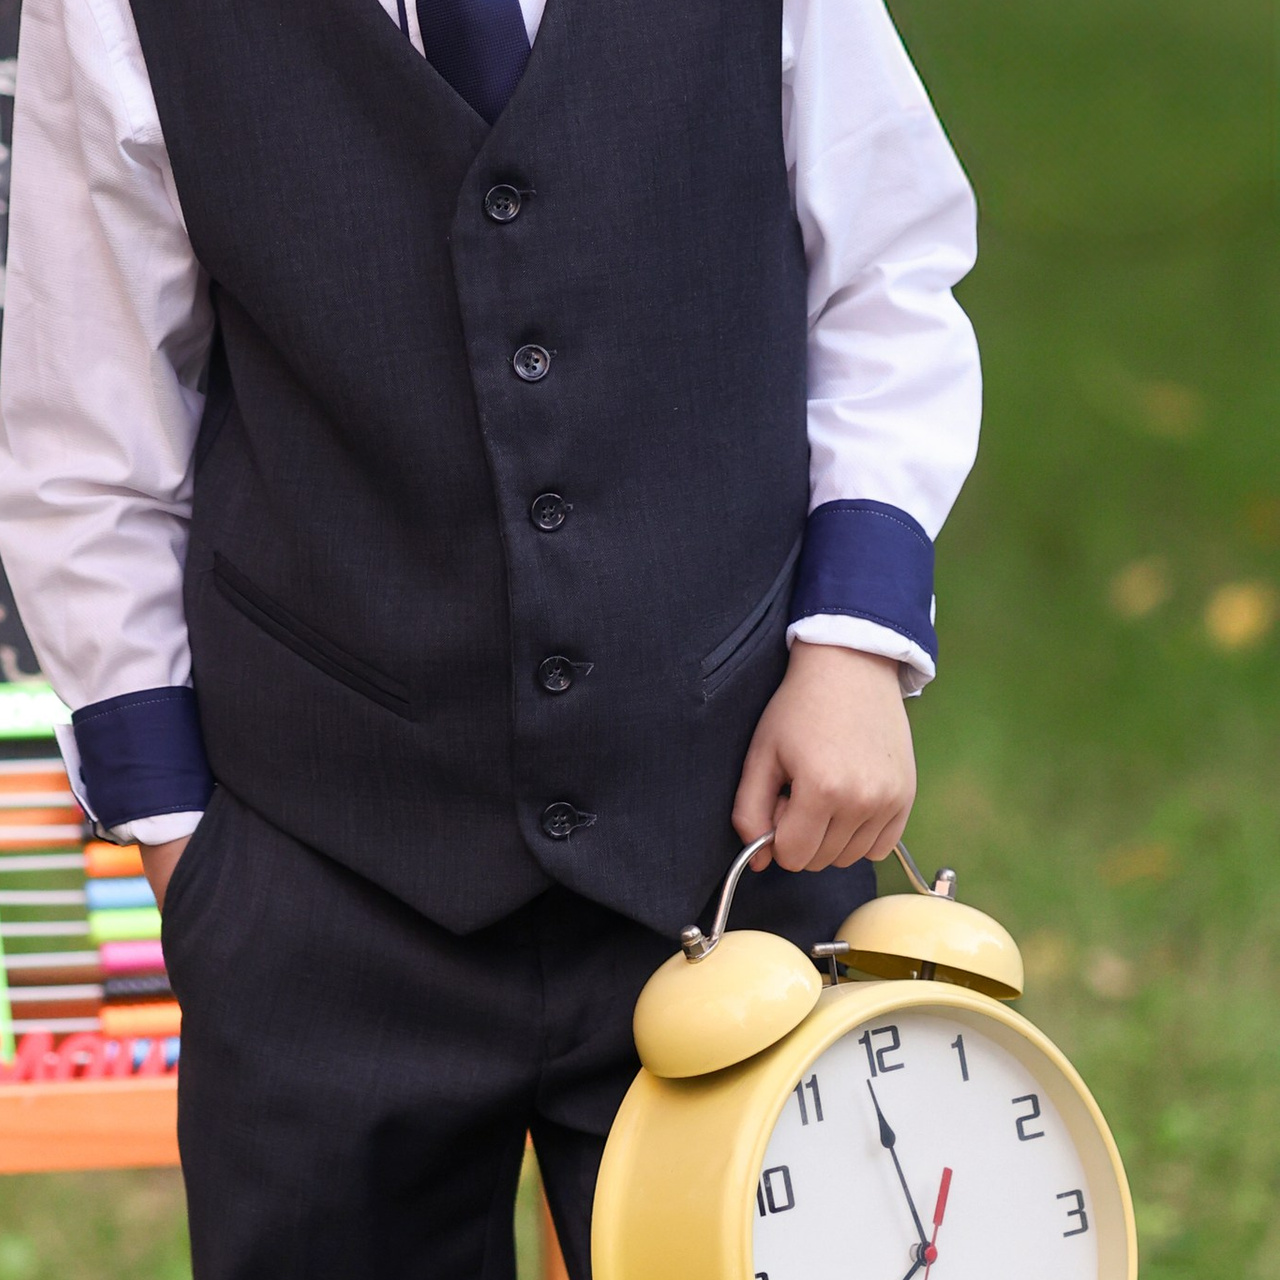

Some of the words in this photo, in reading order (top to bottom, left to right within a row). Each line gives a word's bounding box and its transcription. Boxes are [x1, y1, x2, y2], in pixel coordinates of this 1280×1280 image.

[858, 1024, 905, 1078] 12
[951, 1033, 971, 1082] 1
[793, 1073, 825, 1126] 11
[1011, 1092, 1046, 1142] 2
[1056, 1188, 1090, 1238] 3
